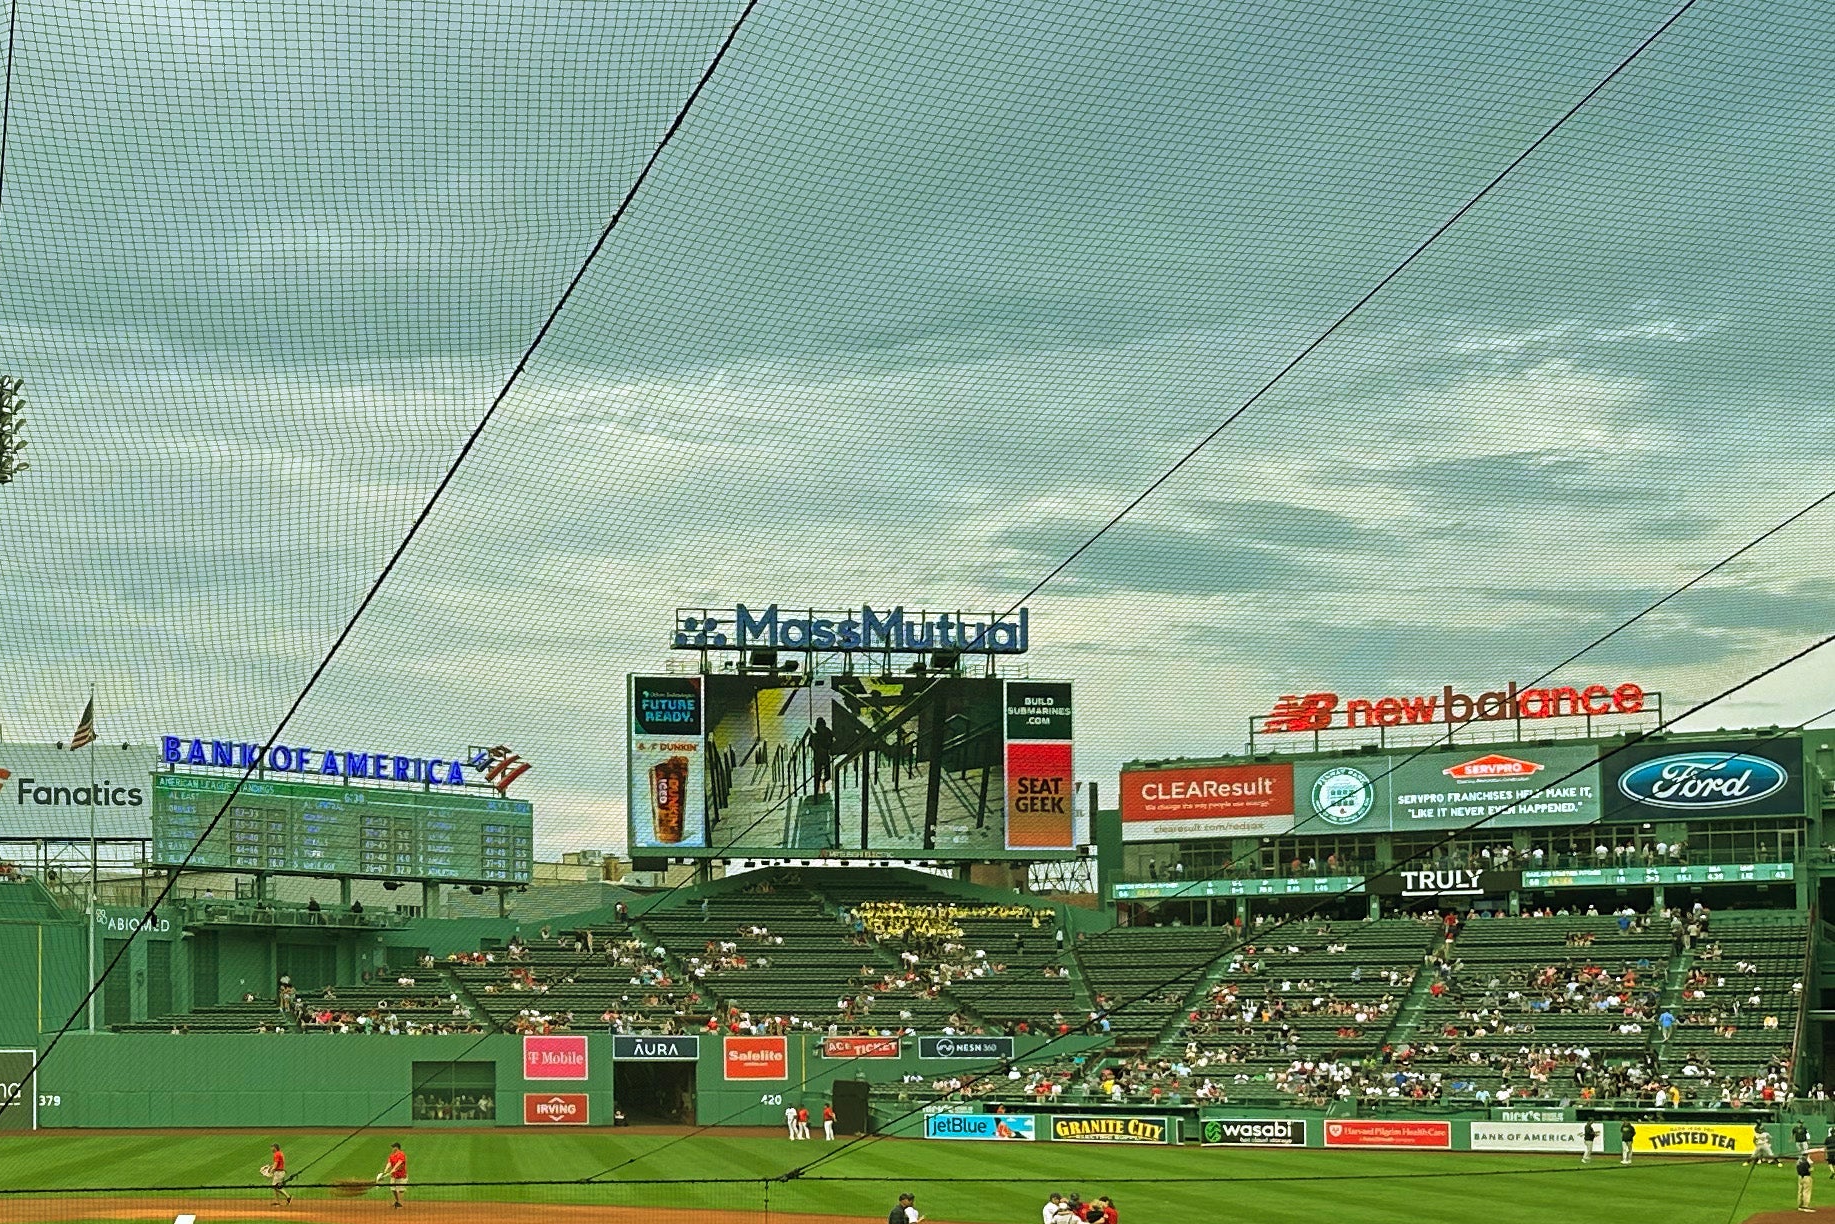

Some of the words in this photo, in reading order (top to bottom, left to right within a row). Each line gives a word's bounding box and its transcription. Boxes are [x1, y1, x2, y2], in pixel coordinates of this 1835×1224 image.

[736, 603, 1029, 650] MassMutual
[642, 699, 695, 711] FUTURE
[1024, 697, 1054, 706] BUILD
[1347, 698, 1442, 728] new
[1444, 682, 1645, 724] balance
[645, 711, 694, 723] READY.
[1007, 706, 1071, 716] SUBMARINES
[1026, 716, 1051, 725] .COM
[163, 736, 262, 769] BANK
[271, 744, 311, 773] OF
[321, 749, 466, 785] AMERICA
[1465, 763, 1523, 775] SERVPRO
[1017, 777, 1063, 795] SEAT
[1654, 762, 1757, 799] Ford
[18, 778, 143, 807] Fanatics
[1141, 777, 1273, 800] CLEAResult
[1398, 793, 1445, 805] SERVPRO
[1448, 790, 1513, 803] FRANCHISES
[1546, 786, 1577, 798] MAKE
[1580, 785, 1593, 798] IT,
[1015, 796, 1065, 814] GEEK
[1437, 807, 1447, 817] IT
[1451, 806, 1484, 817] NEVER
[1401, 869, 1483, 889] TRULY
[108, 915, 170, 933] ABIOMED
[828, 1042, 852, 1052] ACE
[854, 1041, 898, 1055] TICKET
[956, 1043, 981, 1053] NESN
[729, 1050, 783, 1063] Safelite
[39, 1095, 61, 1107] 379
[761, 1093, 782, 1106] 420
[536, 1104, 576, 1115] IRVING
[932, 1116, 987, 1136] jetBlue
[1056, 1119, 1125, 1137] GRANITE
[1128, 1118, 1164, 1140] CITY
[1222, 1121, 1292, 1138] wasabi
[1344, 1126, 1373, 1136] Harvard
[1374, 1126, 1402, 1137] Pilgrim
[1474, 1133, 1504, 1142] BANK
[1506, 1133, 1521, 1142] OF
[1523, 1133, 1575, 1142] AMERICA
[1649, 1132, 1709, 1150] TWISTED
[1711, 1134, 1736, 1151] TEA
